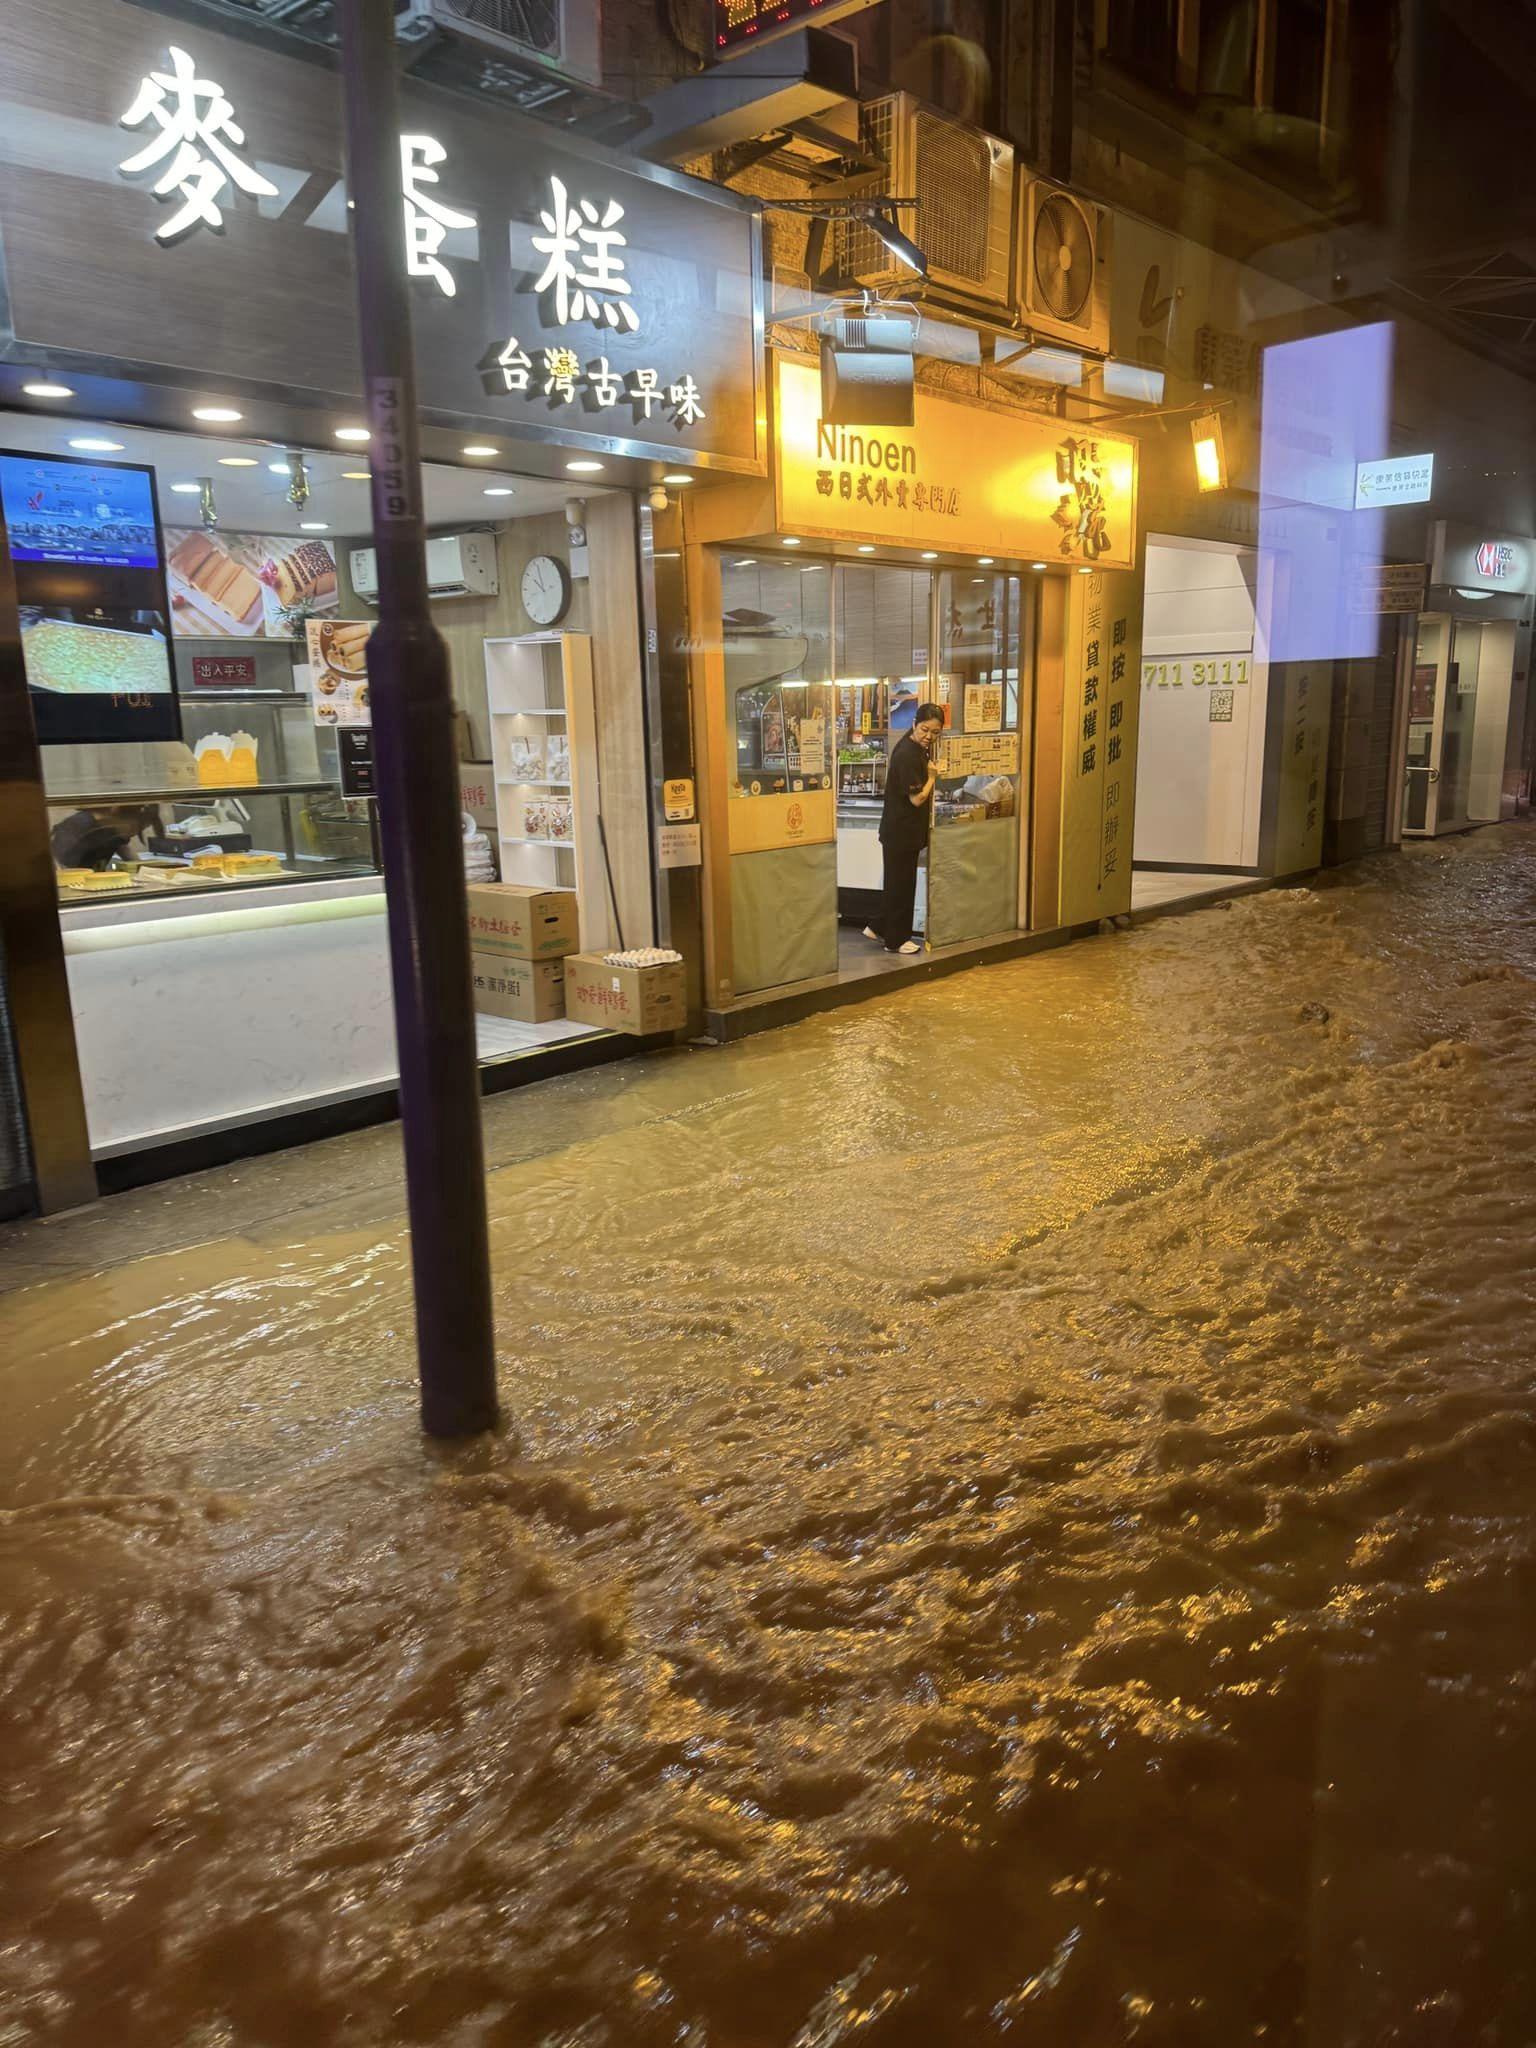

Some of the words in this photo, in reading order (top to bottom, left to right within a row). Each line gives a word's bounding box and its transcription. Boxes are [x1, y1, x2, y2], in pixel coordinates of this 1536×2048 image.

[497, 336, 706, 426] 台灣古早味
[816, 419, 917, 474] Ninoen
[816, 469, 962, 517] 西日式外賣專門店
[200, 663, 249, 679] 出入平安
[1111, 617, 1127, 685] 即按
[1191, 658, 1249, 686] 3111
[1107, 701, 1124, 767] 即批
